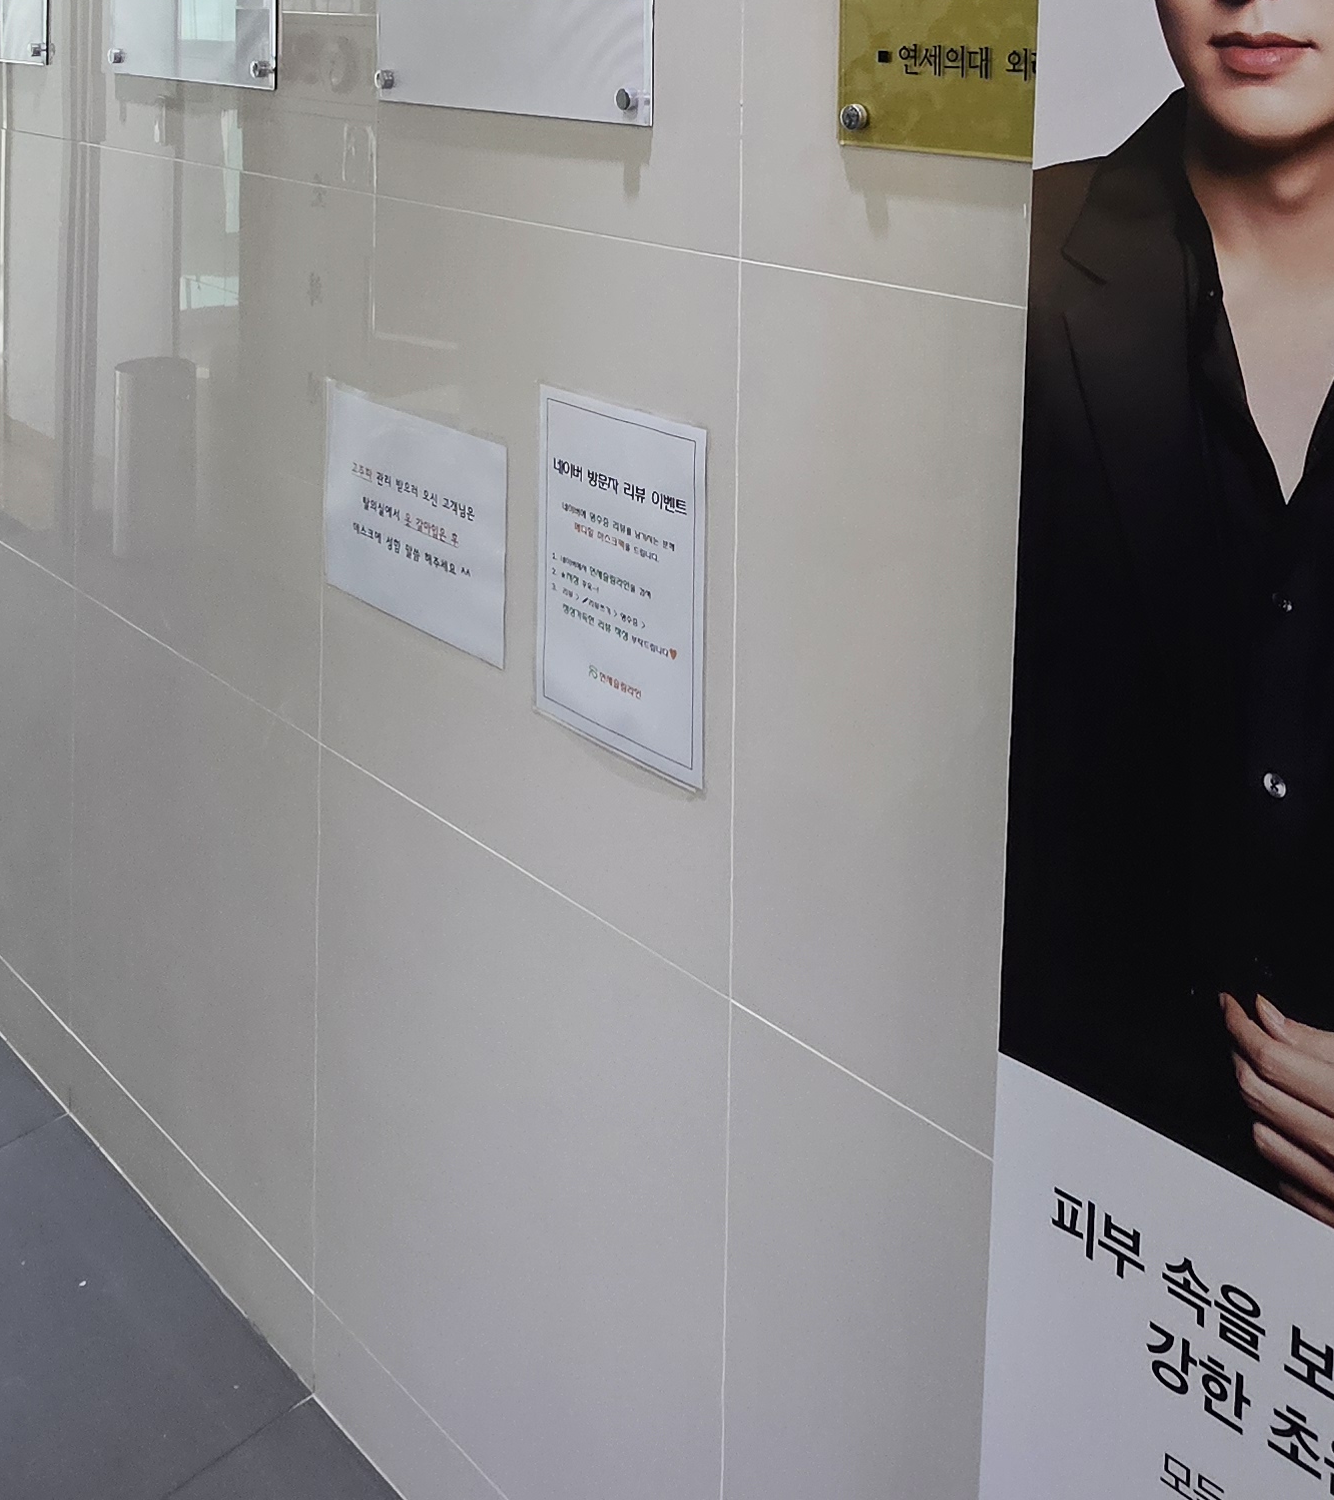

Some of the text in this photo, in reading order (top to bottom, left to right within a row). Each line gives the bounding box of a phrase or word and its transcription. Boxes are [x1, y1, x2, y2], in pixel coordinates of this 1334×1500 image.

[898, 44, 1036, 81] 연세의대 외
[422, 489, 438, 508] 오신
[442, 497, 476, 522] 고객님은
[553, 457, 688, 516] 네이버 방문자 리뷰 이벤트
[1051, 1187, 1145, 1279] 피부
[1162, 1257, 1266, 1362] 속을
[1146, 1321, 1251, 1435] 강한
